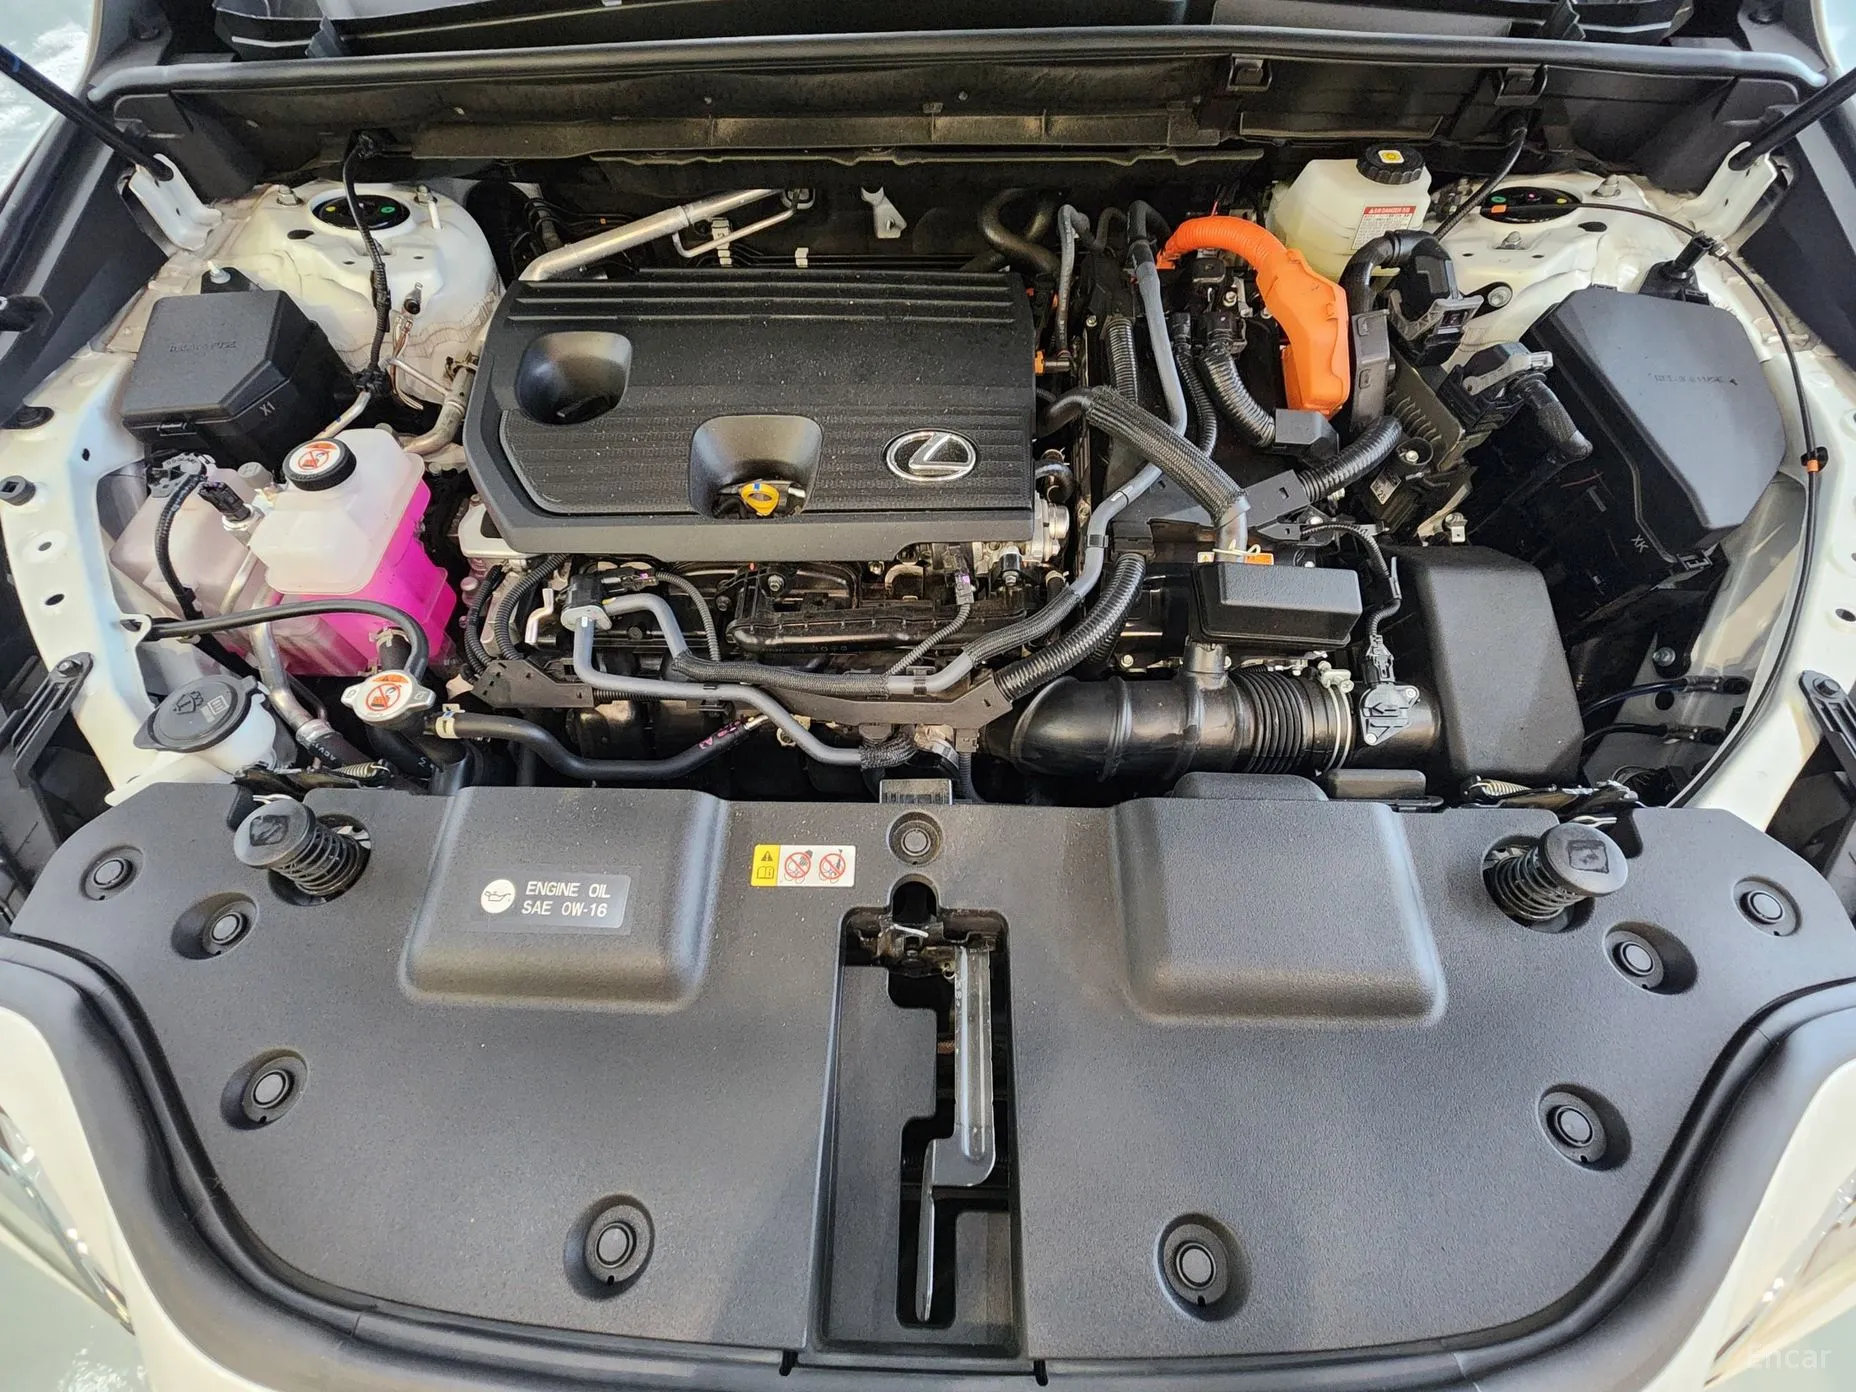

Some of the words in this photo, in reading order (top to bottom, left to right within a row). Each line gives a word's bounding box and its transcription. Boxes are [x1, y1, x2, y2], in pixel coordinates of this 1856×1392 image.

[525, 881, 580, 897] ENGINE
[588, 883, 611, 898] OIL
[521, 900, 553, 915] SAE
[561, 902, 607, 917] 0W-16
